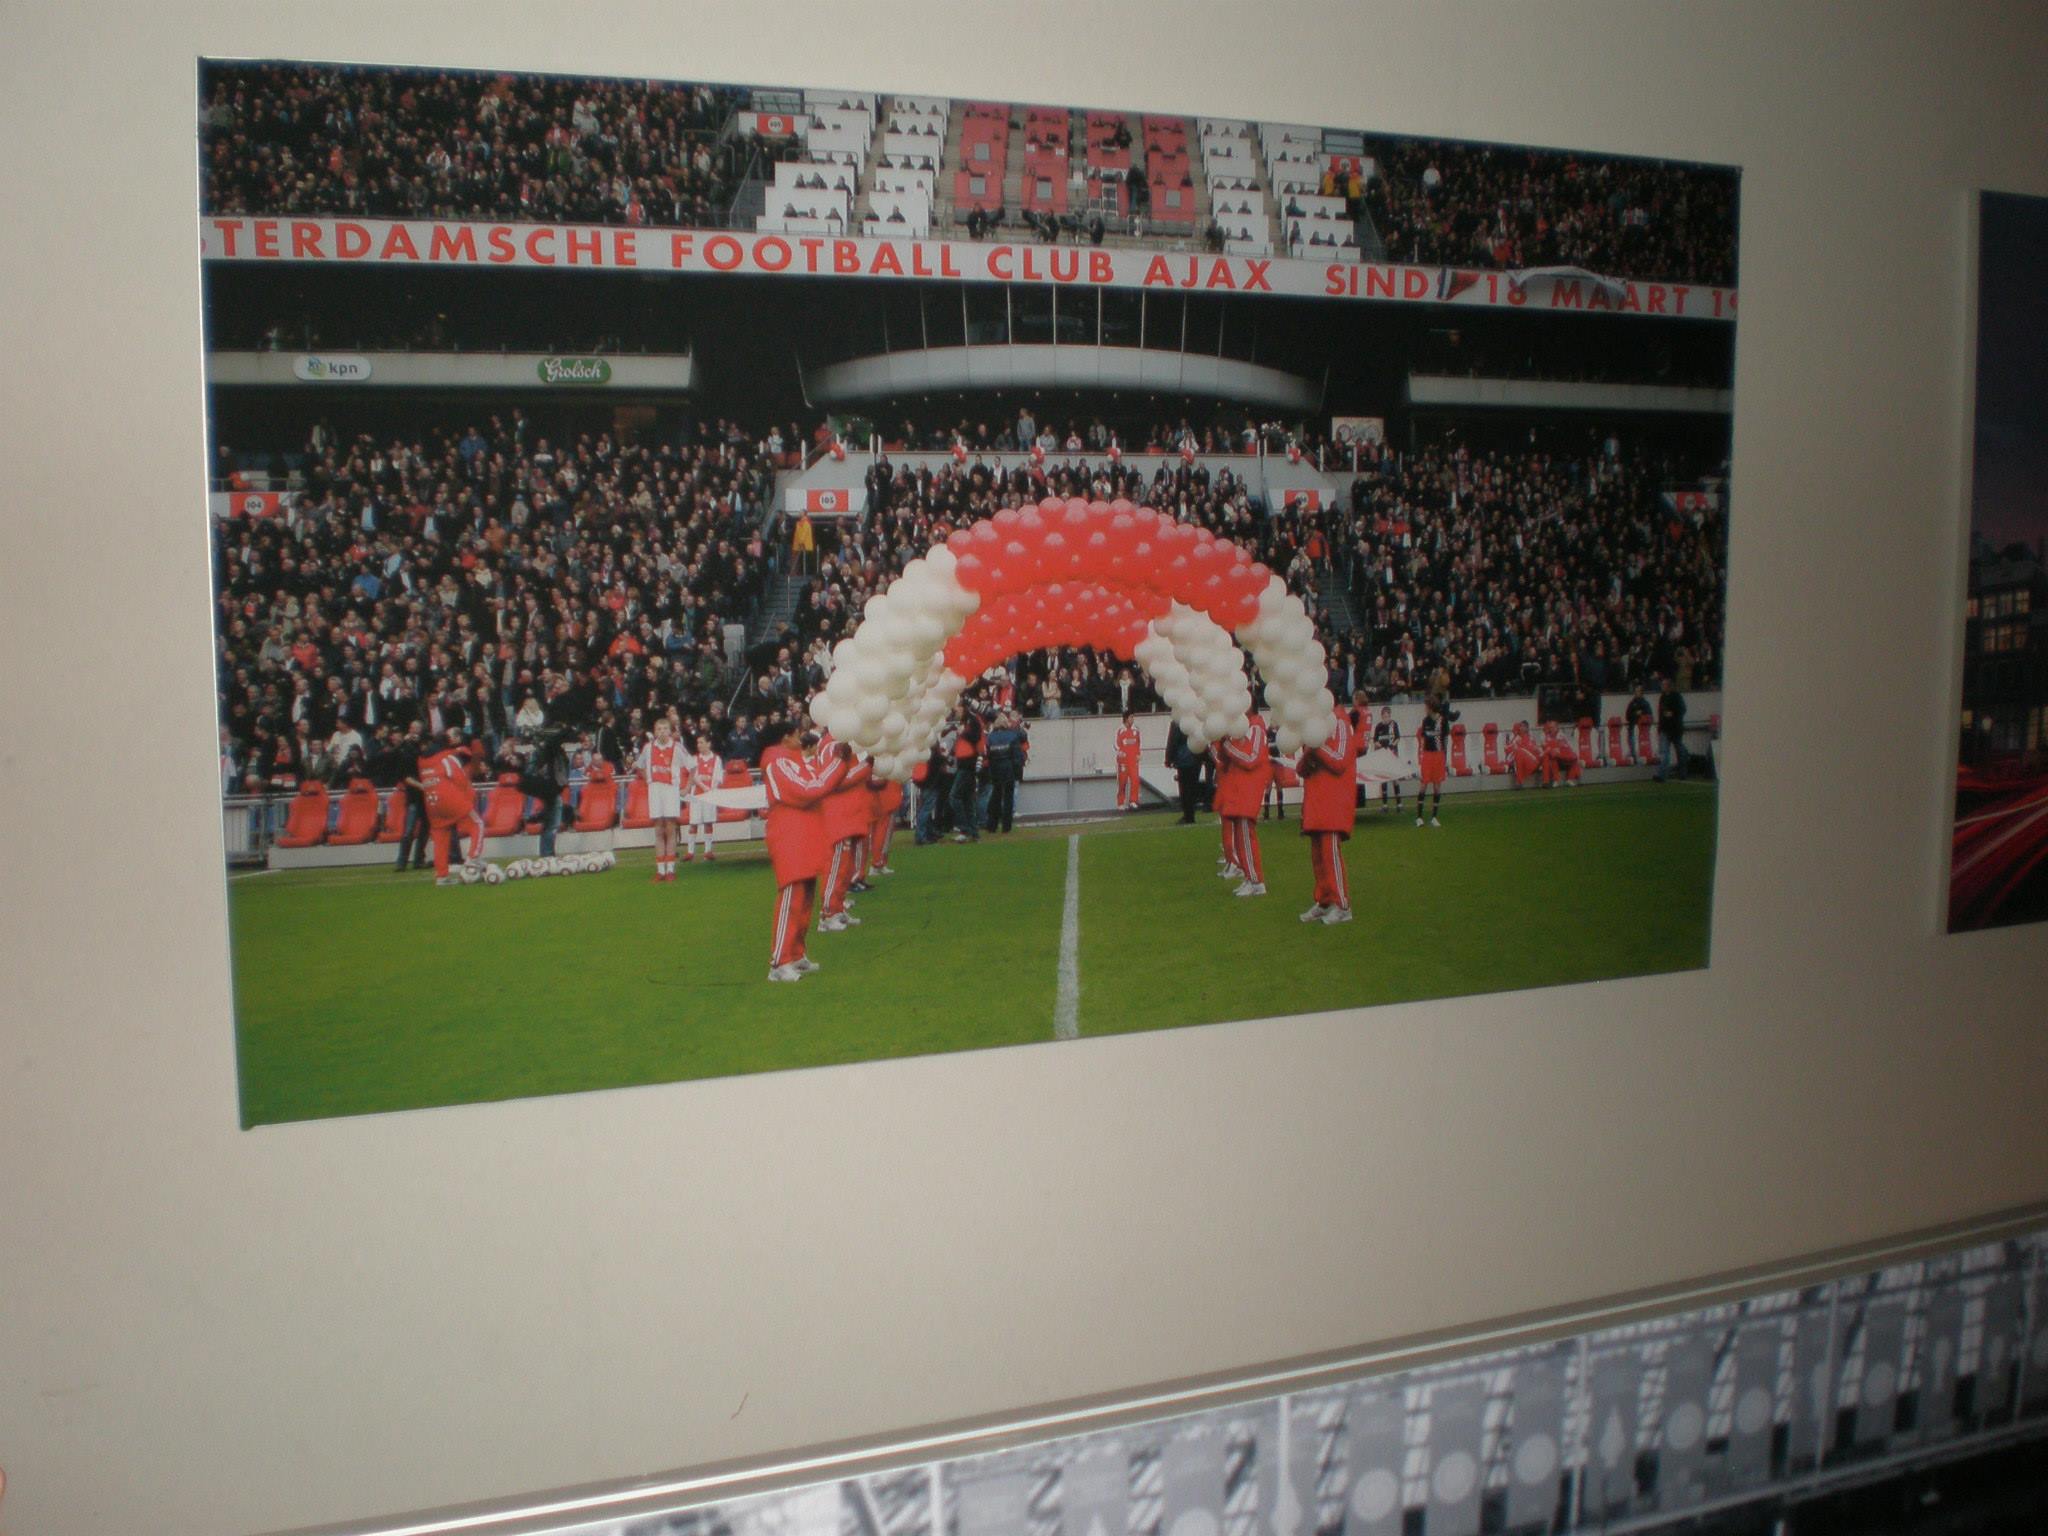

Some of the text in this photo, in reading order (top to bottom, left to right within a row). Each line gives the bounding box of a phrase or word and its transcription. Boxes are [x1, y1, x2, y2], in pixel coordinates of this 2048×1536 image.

[200, 219, 637, 265] TERDAMSCHE
[671, 233, 961, 277] FOOTBALL
[986, 246, 1114, 283] CLUB
[1143, 254, 1273, 291] AJAX
[1325, 263, 1449, 302] SIND
[1551, 279, 1691, 315] MAART
[329, 362, 358, 376] kpn
[545, 358, 602, 382] Grolsch
